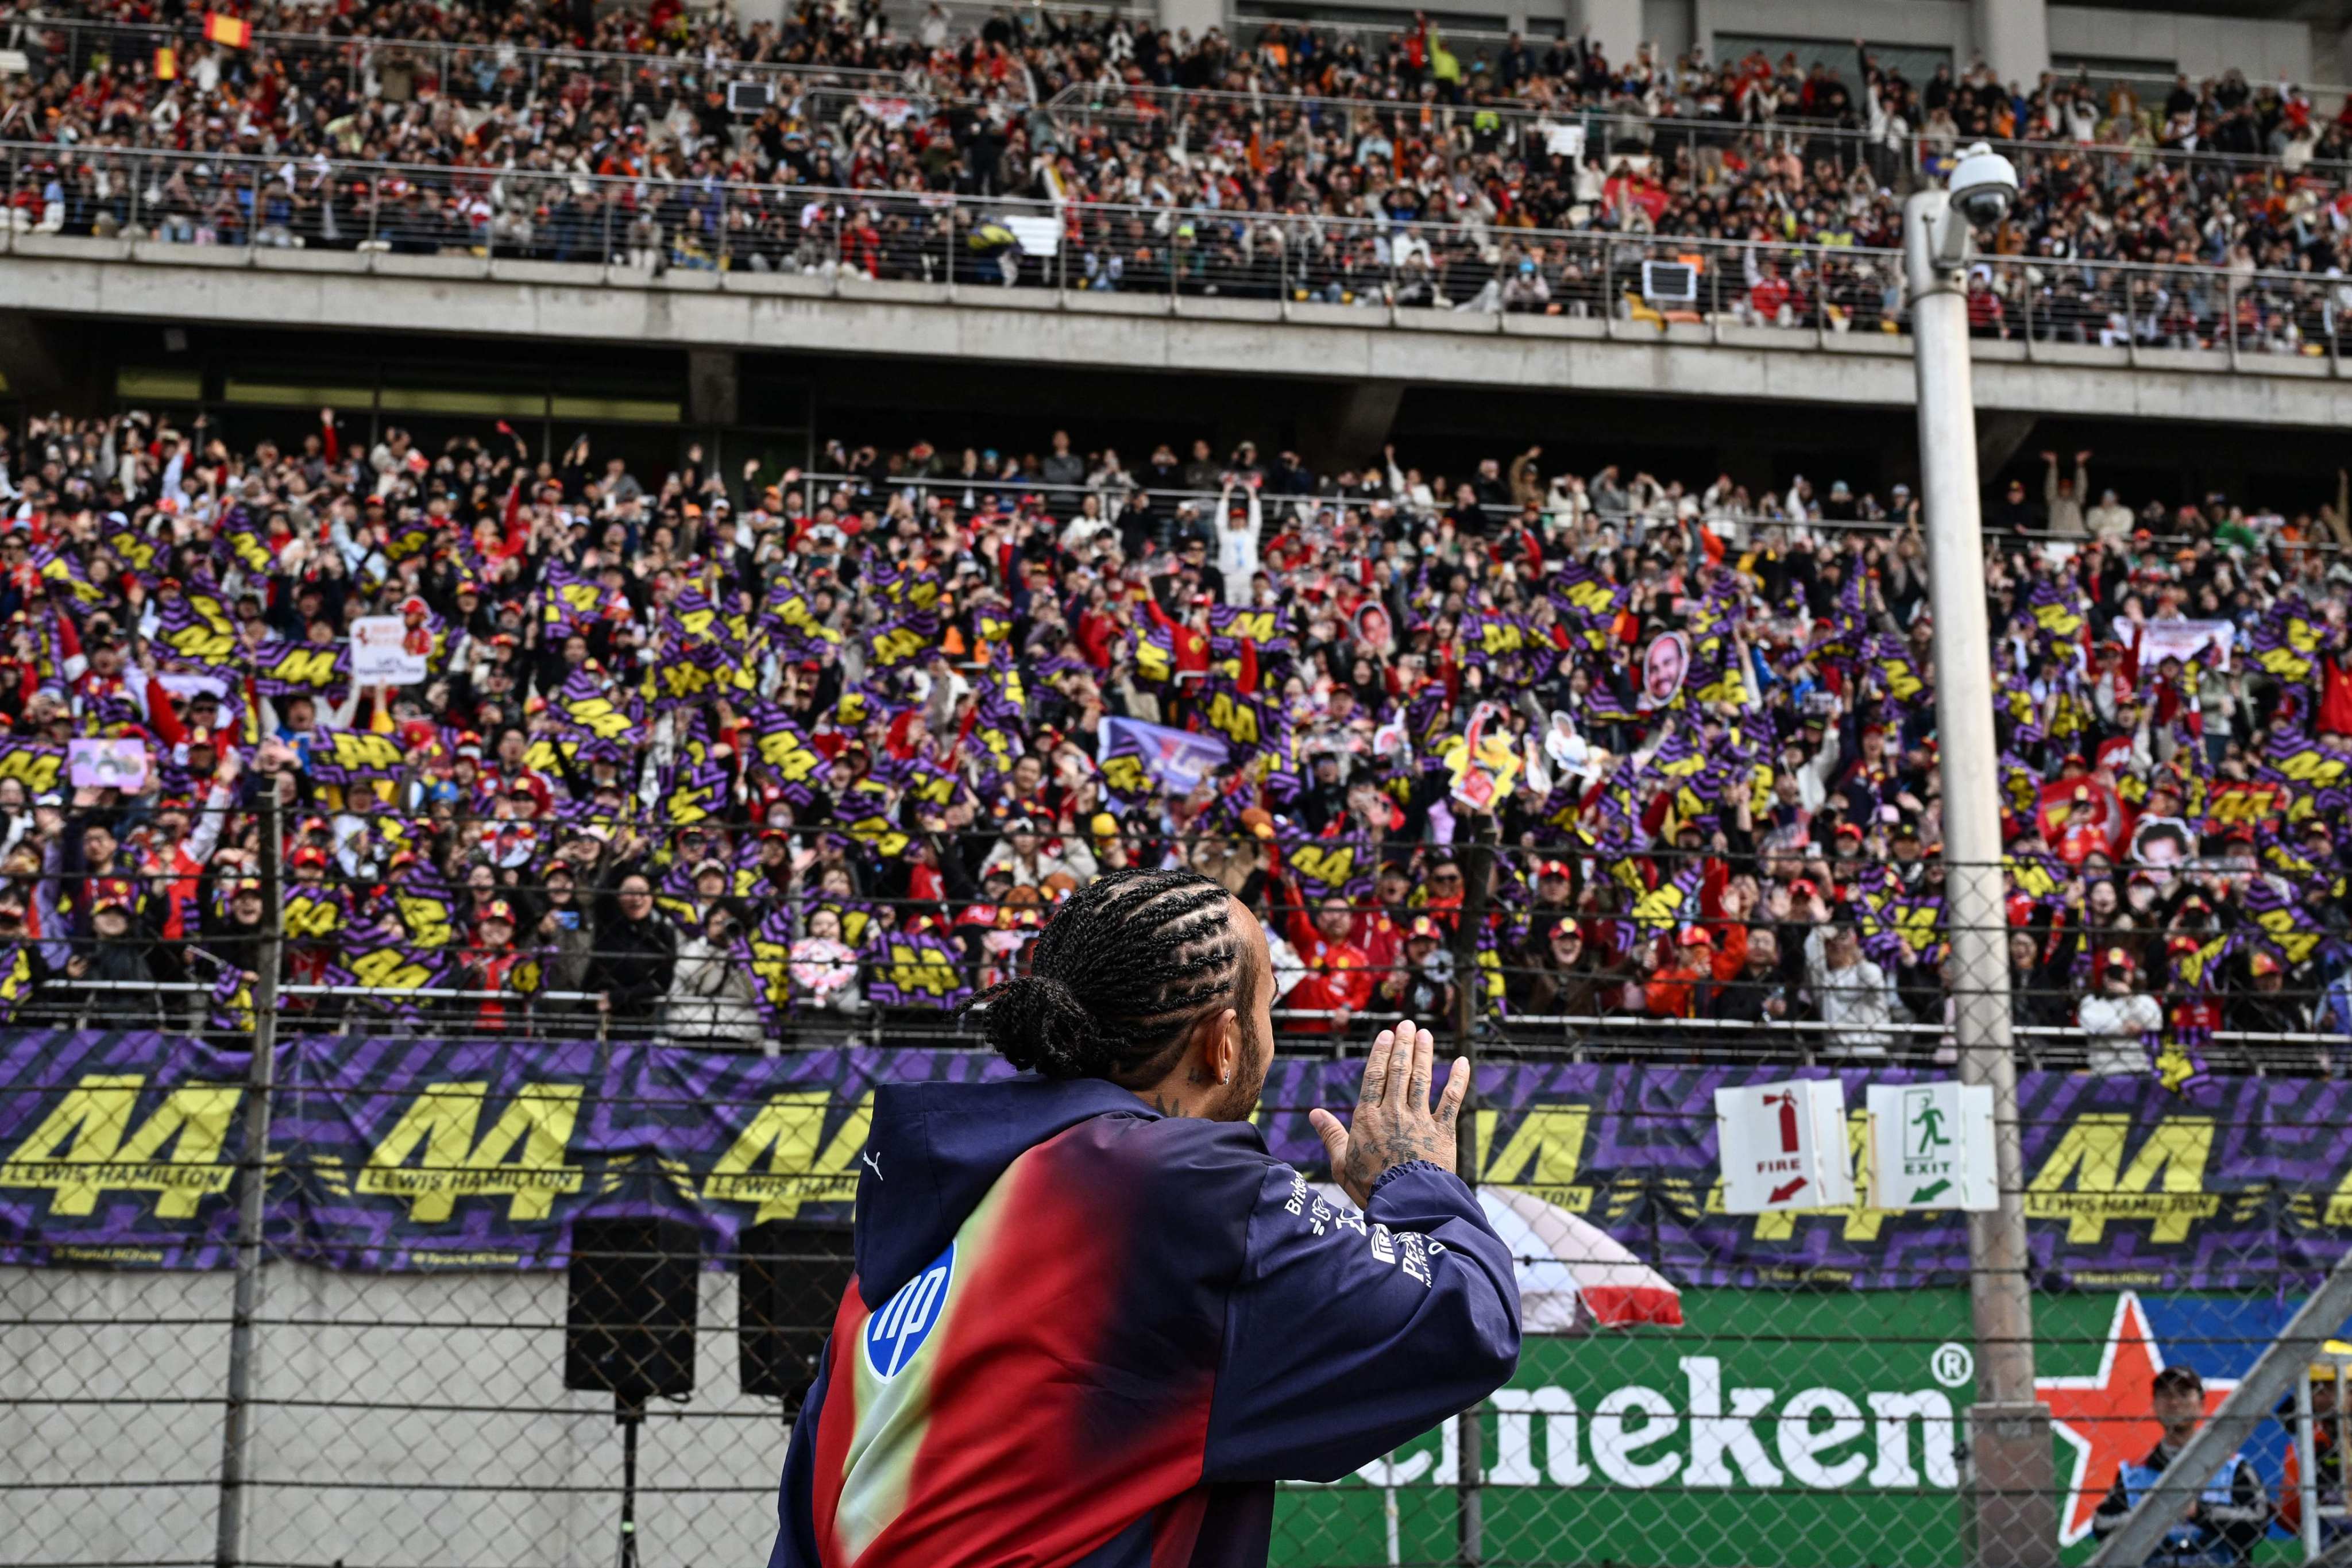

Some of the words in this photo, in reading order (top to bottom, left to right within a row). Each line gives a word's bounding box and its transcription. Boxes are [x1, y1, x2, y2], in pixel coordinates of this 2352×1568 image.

[1566, 581, 1615, 616] 44
[169, 625, 235, 664] 44
[1482, 623, 1523, 655] 44
[275, 648, 338, 686] 44
[565, 697, 632, 738] 44
[1206, 692, 1258, 744] 44
[0, 750, 61, 793] 44
[759, 729, 819, 779] 44
[1289, 845, 1354, 886] 44
[284, 897, 338, 939] 44
[352, 947, 432, 992] 44
[893, 945, 959, 995] 44
[0, 1073, 242, 1216] 44
[355, 1082, 585, 1222] 44
[9, 1165, 87, 1183] LEWIS
[95, 1164, 225, 1186] HAMILTON
[368, 1169, 443, 1191] LEWIS
[450, 1169, 573, 1190] HAMILTON
[715, 1176, 787, 1196] LEWIS
[1756, 1158, 1801, 1173] FIRE
[1903, 1161, 1952, 1175] EXIT
[2025, 1113, 2220, 1242] 44
